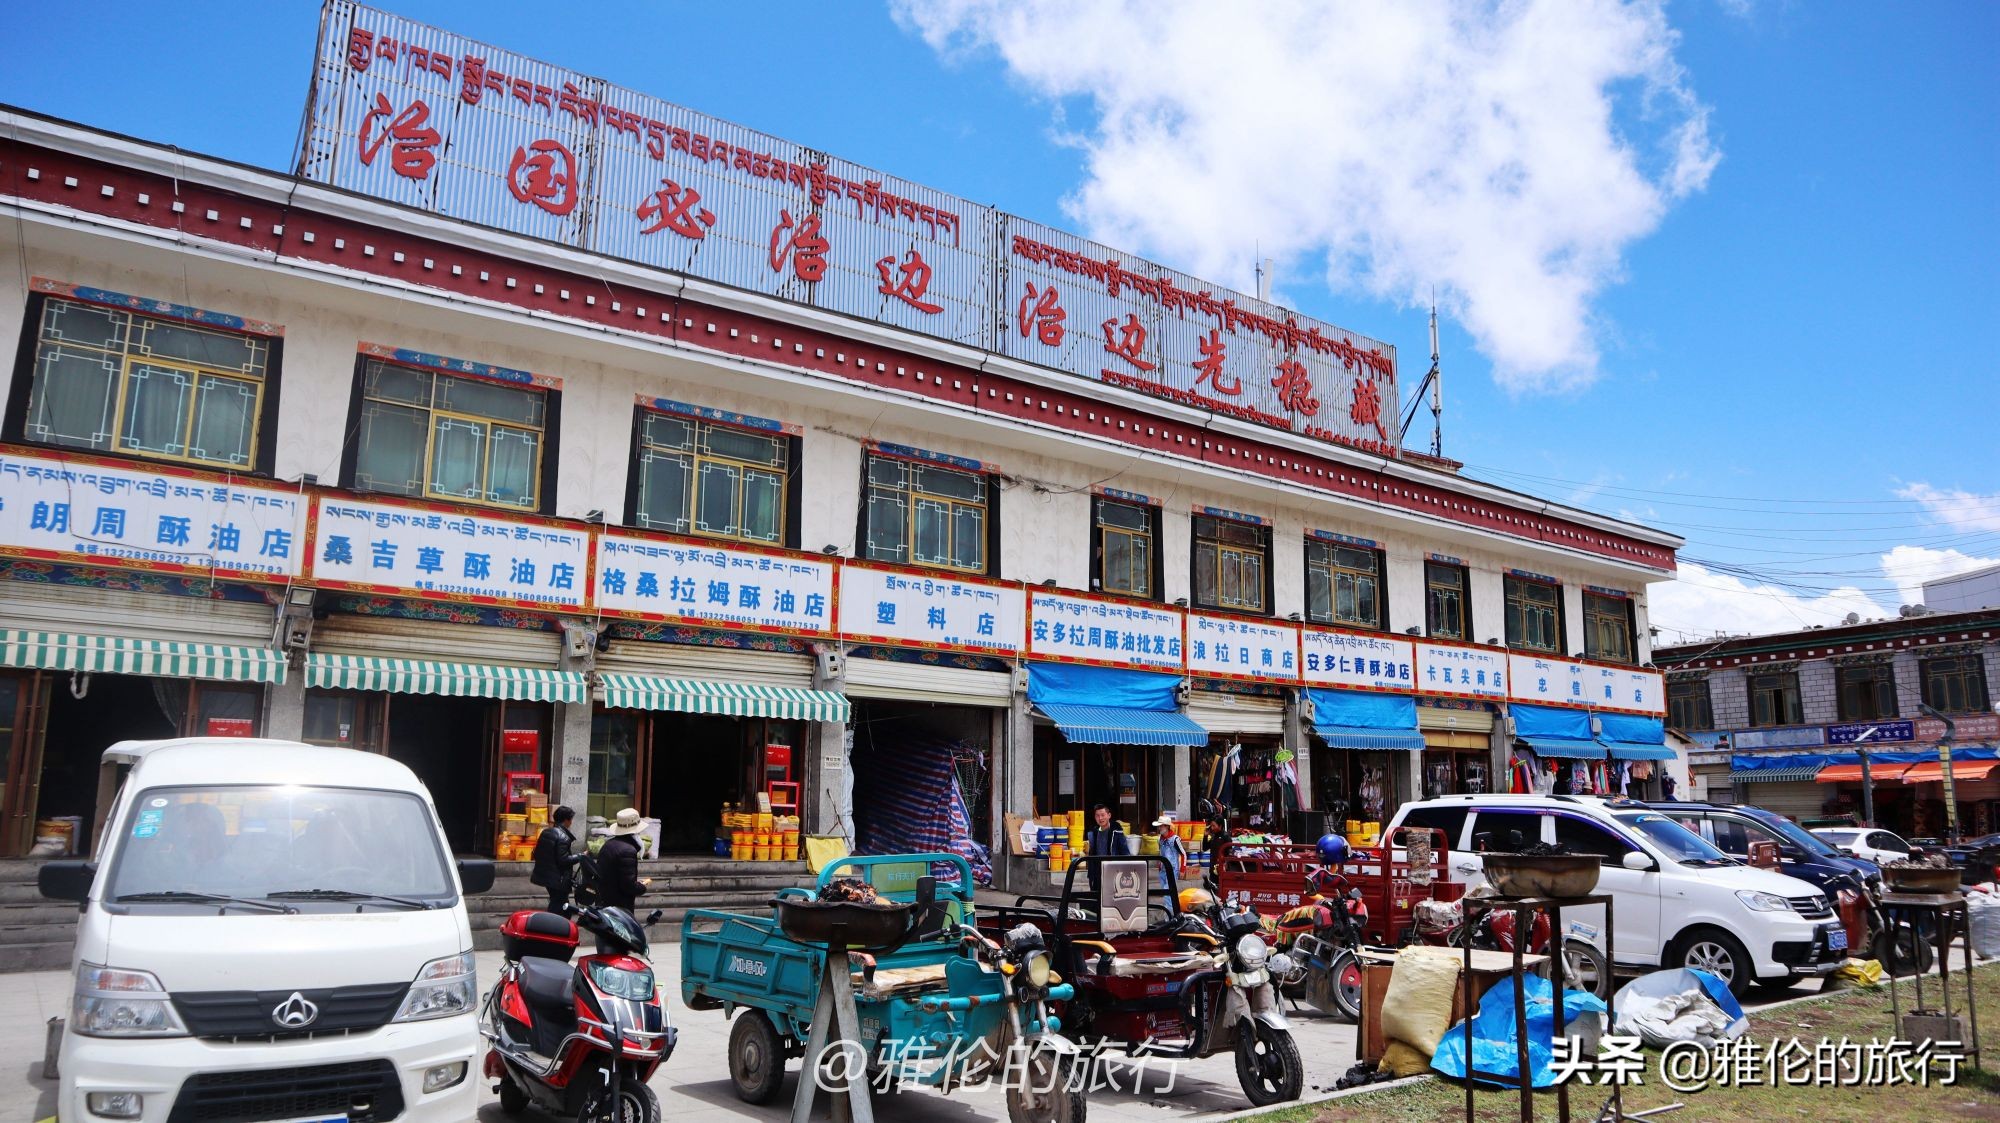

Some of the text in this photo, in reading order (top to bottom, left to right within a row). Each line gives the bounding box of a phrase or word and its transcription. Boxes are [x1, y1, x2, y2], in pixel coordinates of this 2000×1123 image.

[359, 92, 945, 315] 治国必治边
[1018, 281, 1388, 440] 治边先稳藏
[0, 497, 292, 559] 朗周酥油店
[323, 535, 575, 590] 桑吉草酥油店
[602, 568, 825, 618] 格桑拉姆酥油店
[877, 601, 995, 636] 塑料店
[1033, 619, 1181, 657] 安多拉周酥油批发店
[1193, 640, 1293, 669] 浪拉日商店
[1307, 653, 1410, 680] 安多仁青酥油店
[1427, 664, 1502, 688] 卡瓦尖商店
[1538, 677, 1642, 703] 忠信商店
